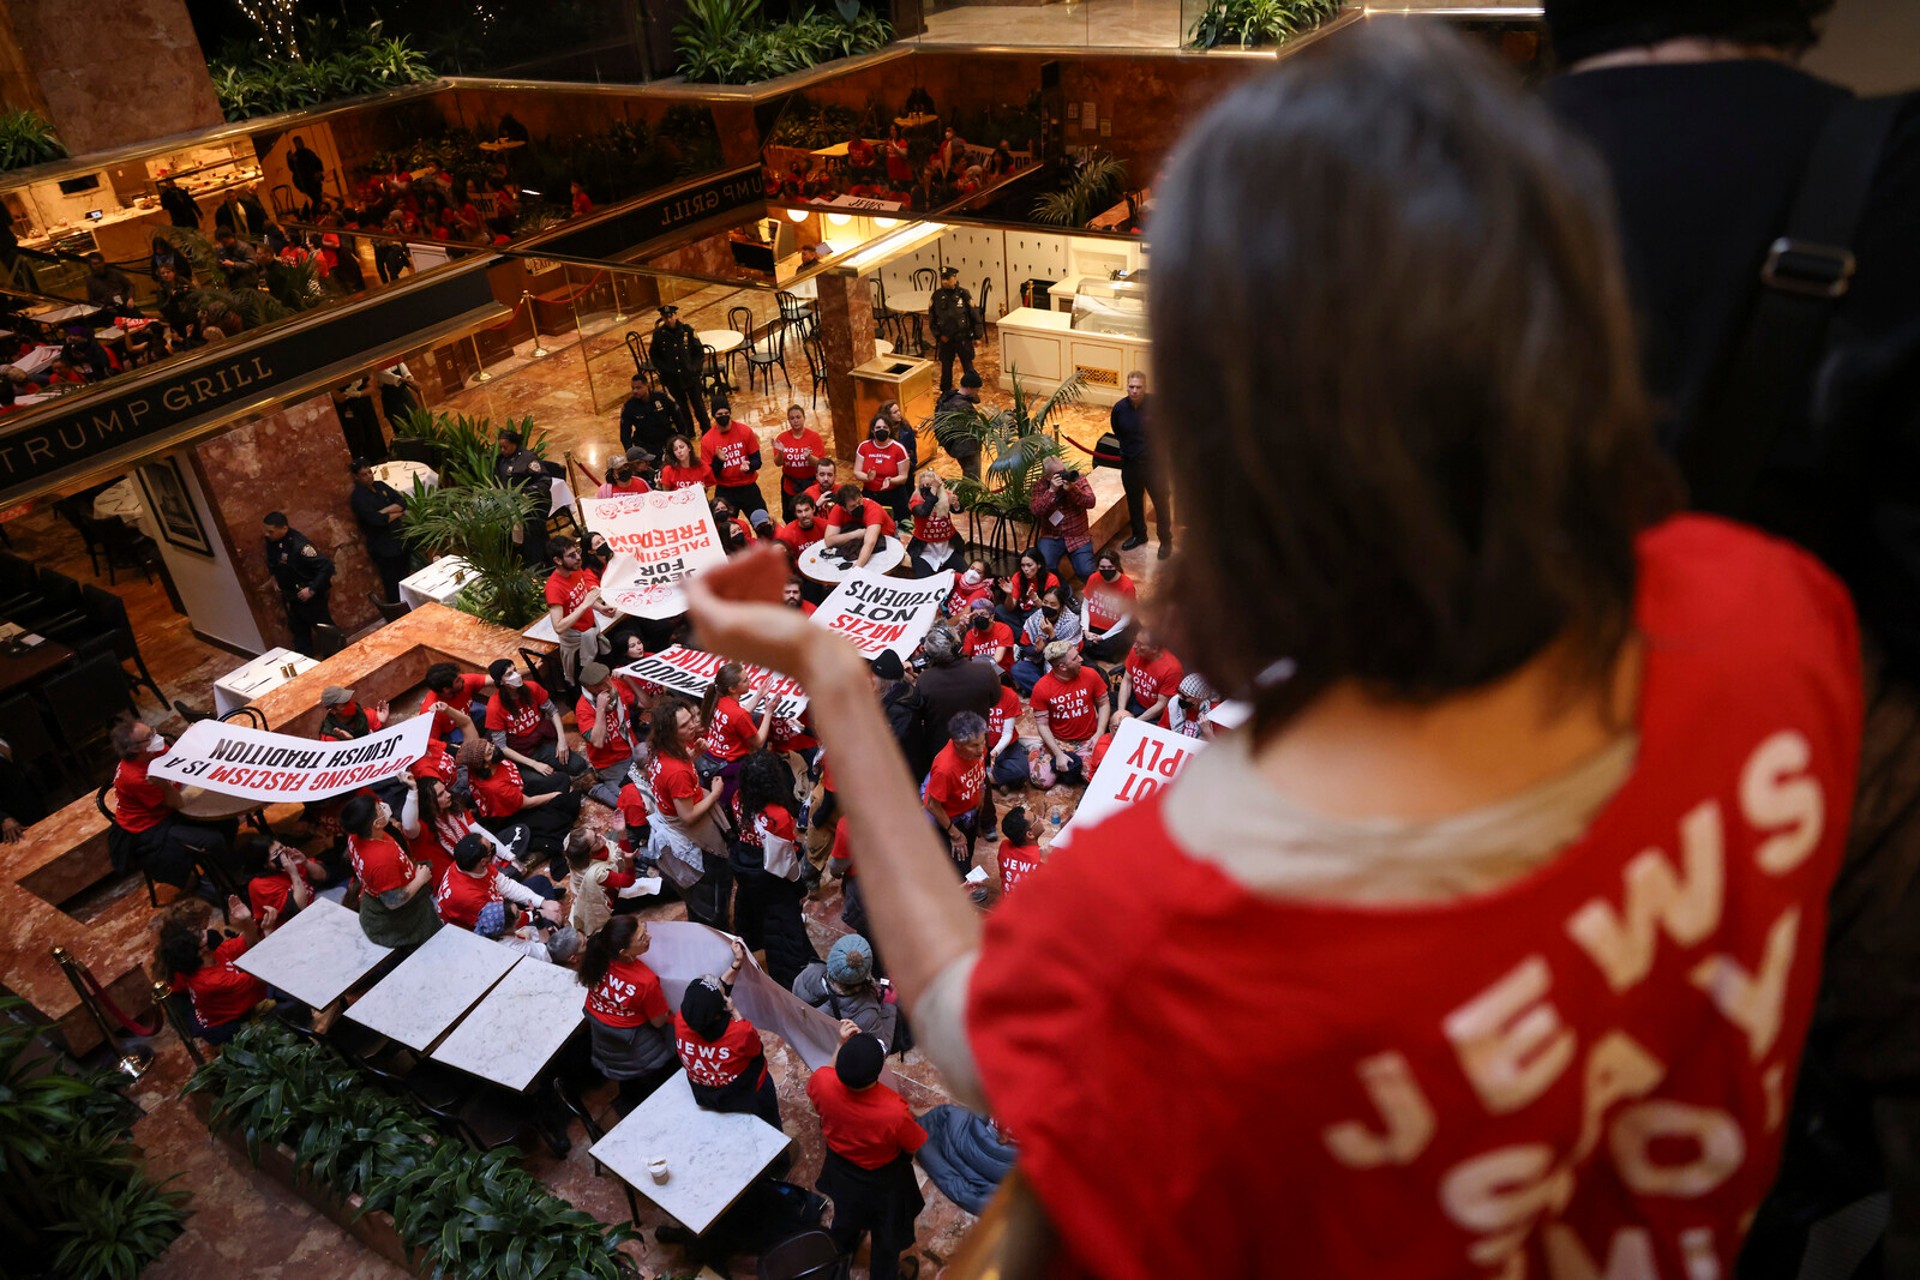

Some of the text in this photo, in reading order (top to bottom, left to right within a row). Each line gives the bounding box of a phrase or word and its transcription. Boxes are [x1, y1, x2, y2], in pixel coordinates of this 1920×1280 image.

[0, 357, 273, 474] TRUMP GRILL
[608, 518, 708, 550] FREEDOM
[639, 558, 685, 577] FOR
[845, 580, 946, 607] STUDENTS
[845, 603, 919, 623] NOT
[828, 613, 908, 643] NAZIS
[1050, 688, 1088, 705] NOT IN
[1056, 698, 1084, 712] OUR
[211, 734, 403, 769] JEWISH TRADITION
[163, 754, 414, 792] OPPOSING FASCISM IS A
[1322, 729, 1826, 1171] JEWS
[608, 973, 637, 997] WS
[676, 1038, 730, 1060] JEWS
